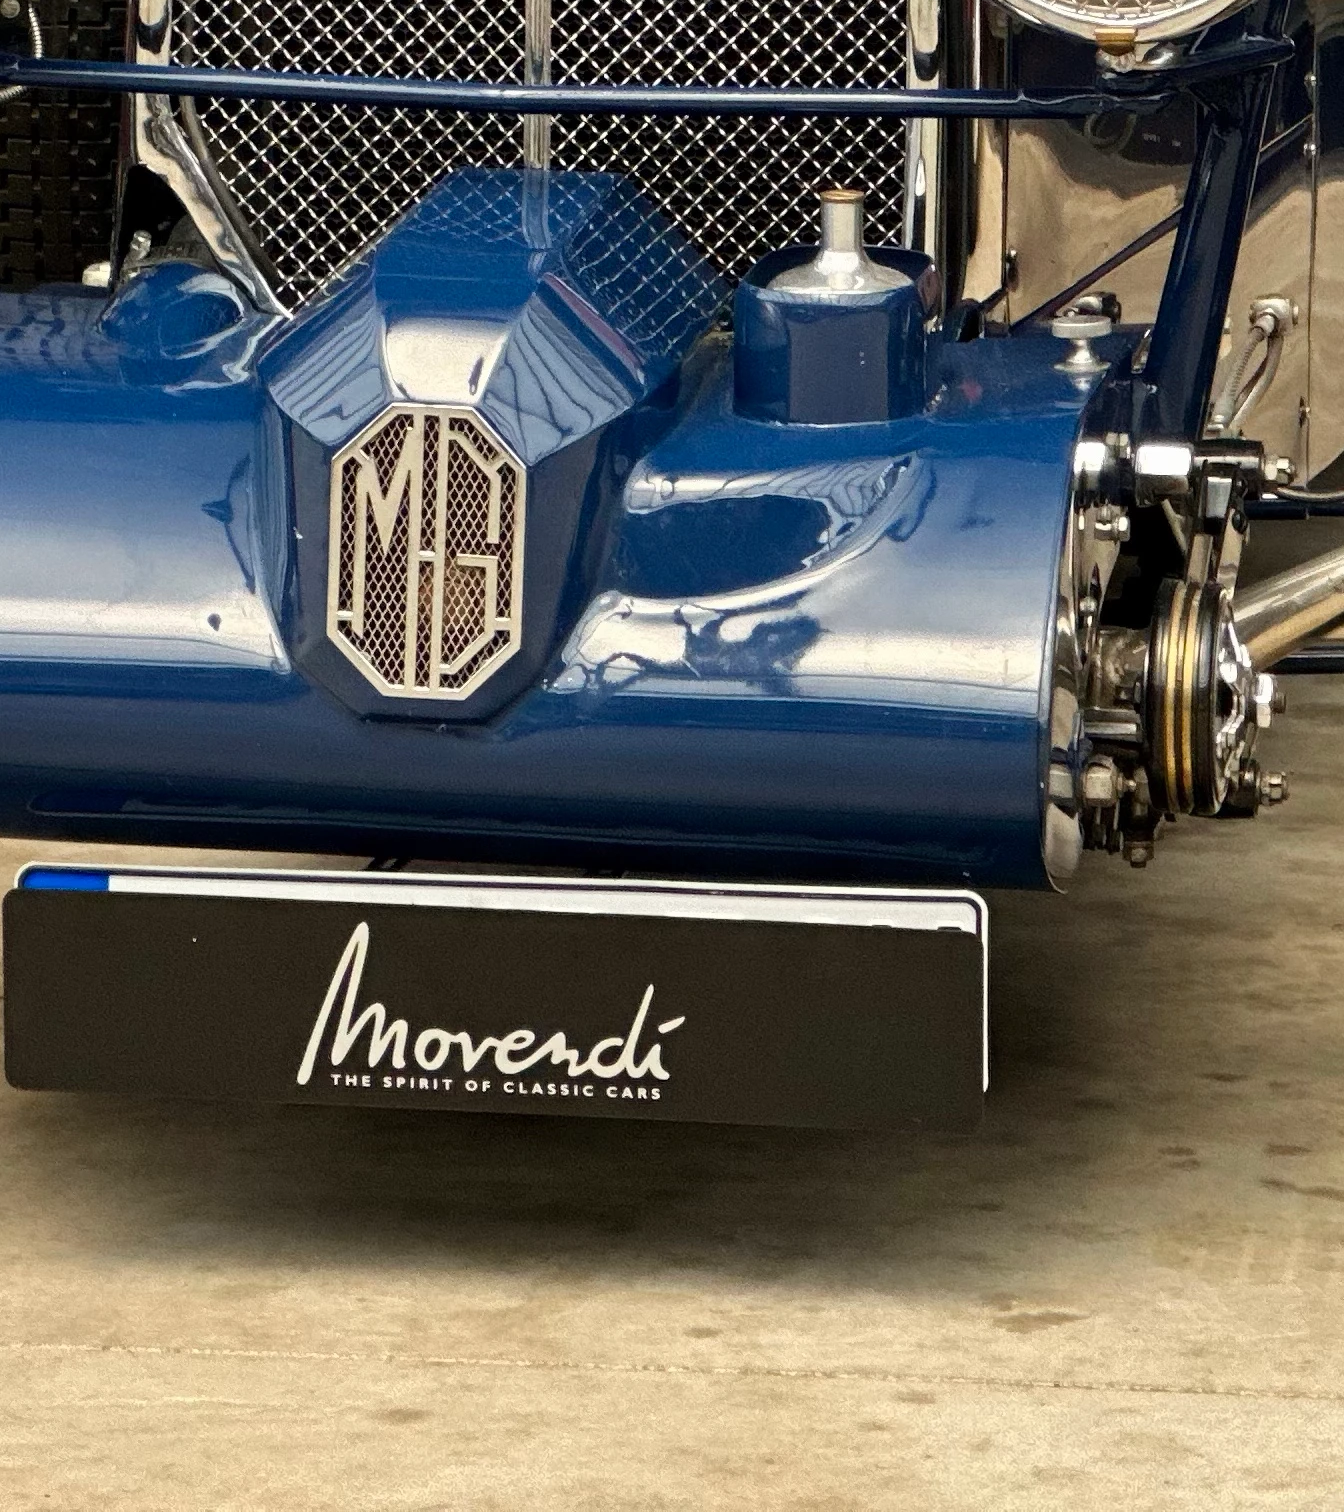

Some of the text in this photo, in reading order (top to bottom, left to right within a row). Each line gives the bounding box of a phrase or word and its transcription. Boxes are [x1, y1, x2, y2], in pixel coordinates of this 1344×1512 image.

[350, 412, 502, 690] MG
[297, 921, 686, 1085] Movendi
[331, 1073, 661, 1100] THE SPIRIT OF CLASSIC CARS
